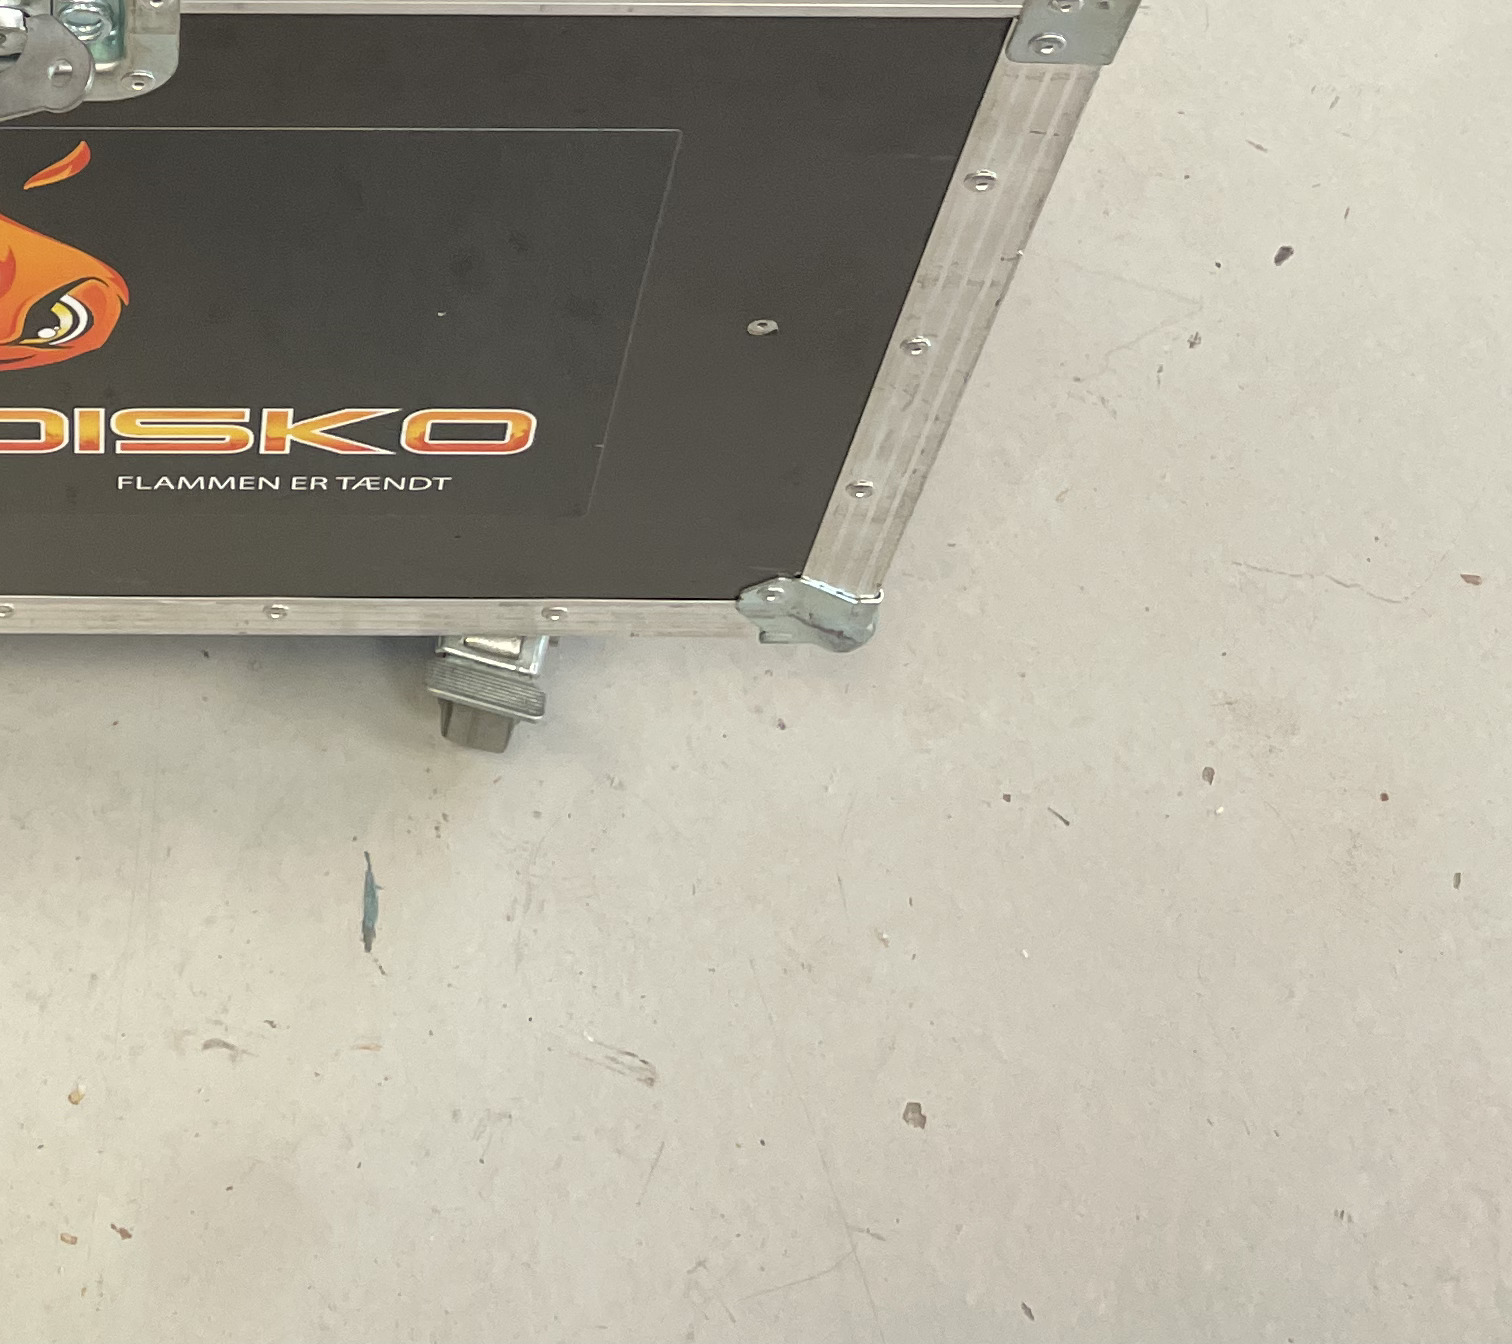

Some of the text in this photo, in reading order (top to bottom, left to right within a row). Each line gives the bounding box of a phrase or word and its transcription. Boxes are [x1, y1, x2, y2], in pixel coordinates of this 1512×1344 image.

[117, 475, 453, 492] FLAMMEN ER TÆNDT
